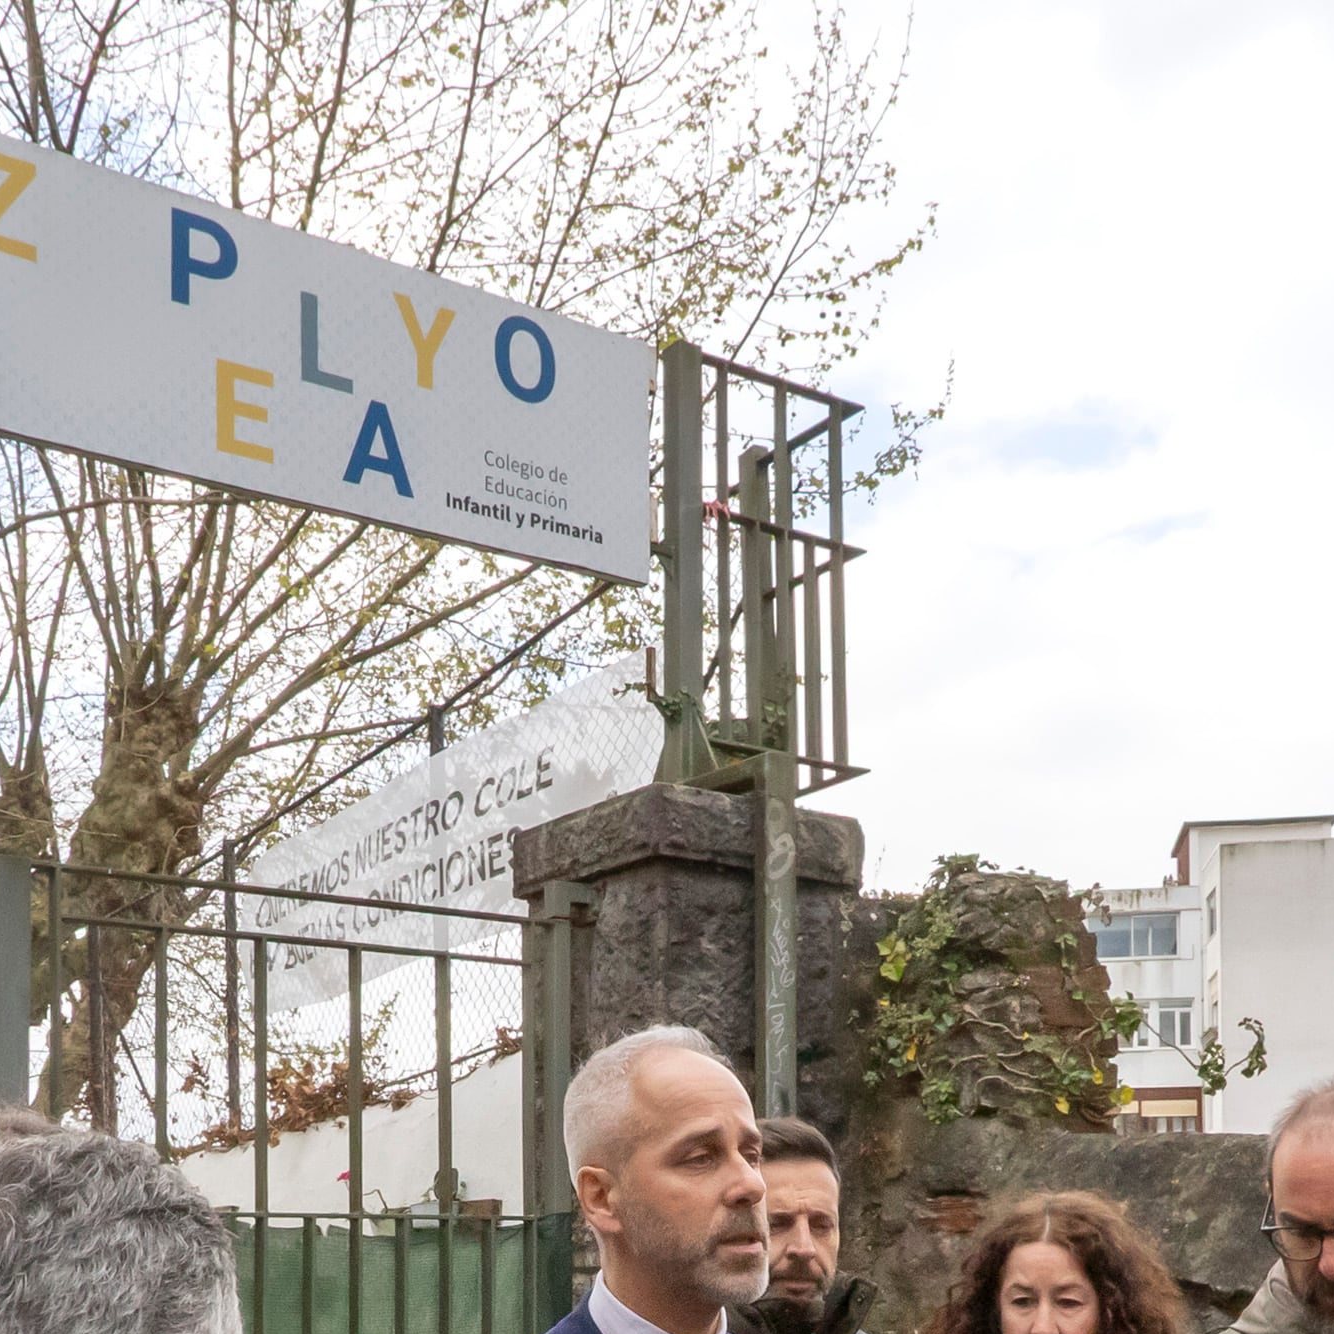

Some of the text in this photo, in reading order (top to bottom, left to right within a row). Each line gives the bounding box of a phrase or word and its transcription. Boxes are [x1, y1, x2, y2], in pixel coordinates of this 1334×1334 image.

[484, 450, 568, 485] Colegio de
[484, 475, 568, 512] Educación
[446, 492, 604, 545] Infantil y Primaria
[354, 790, 465, 879] NUESTRO
[474, 745, 555, 818] COLE
